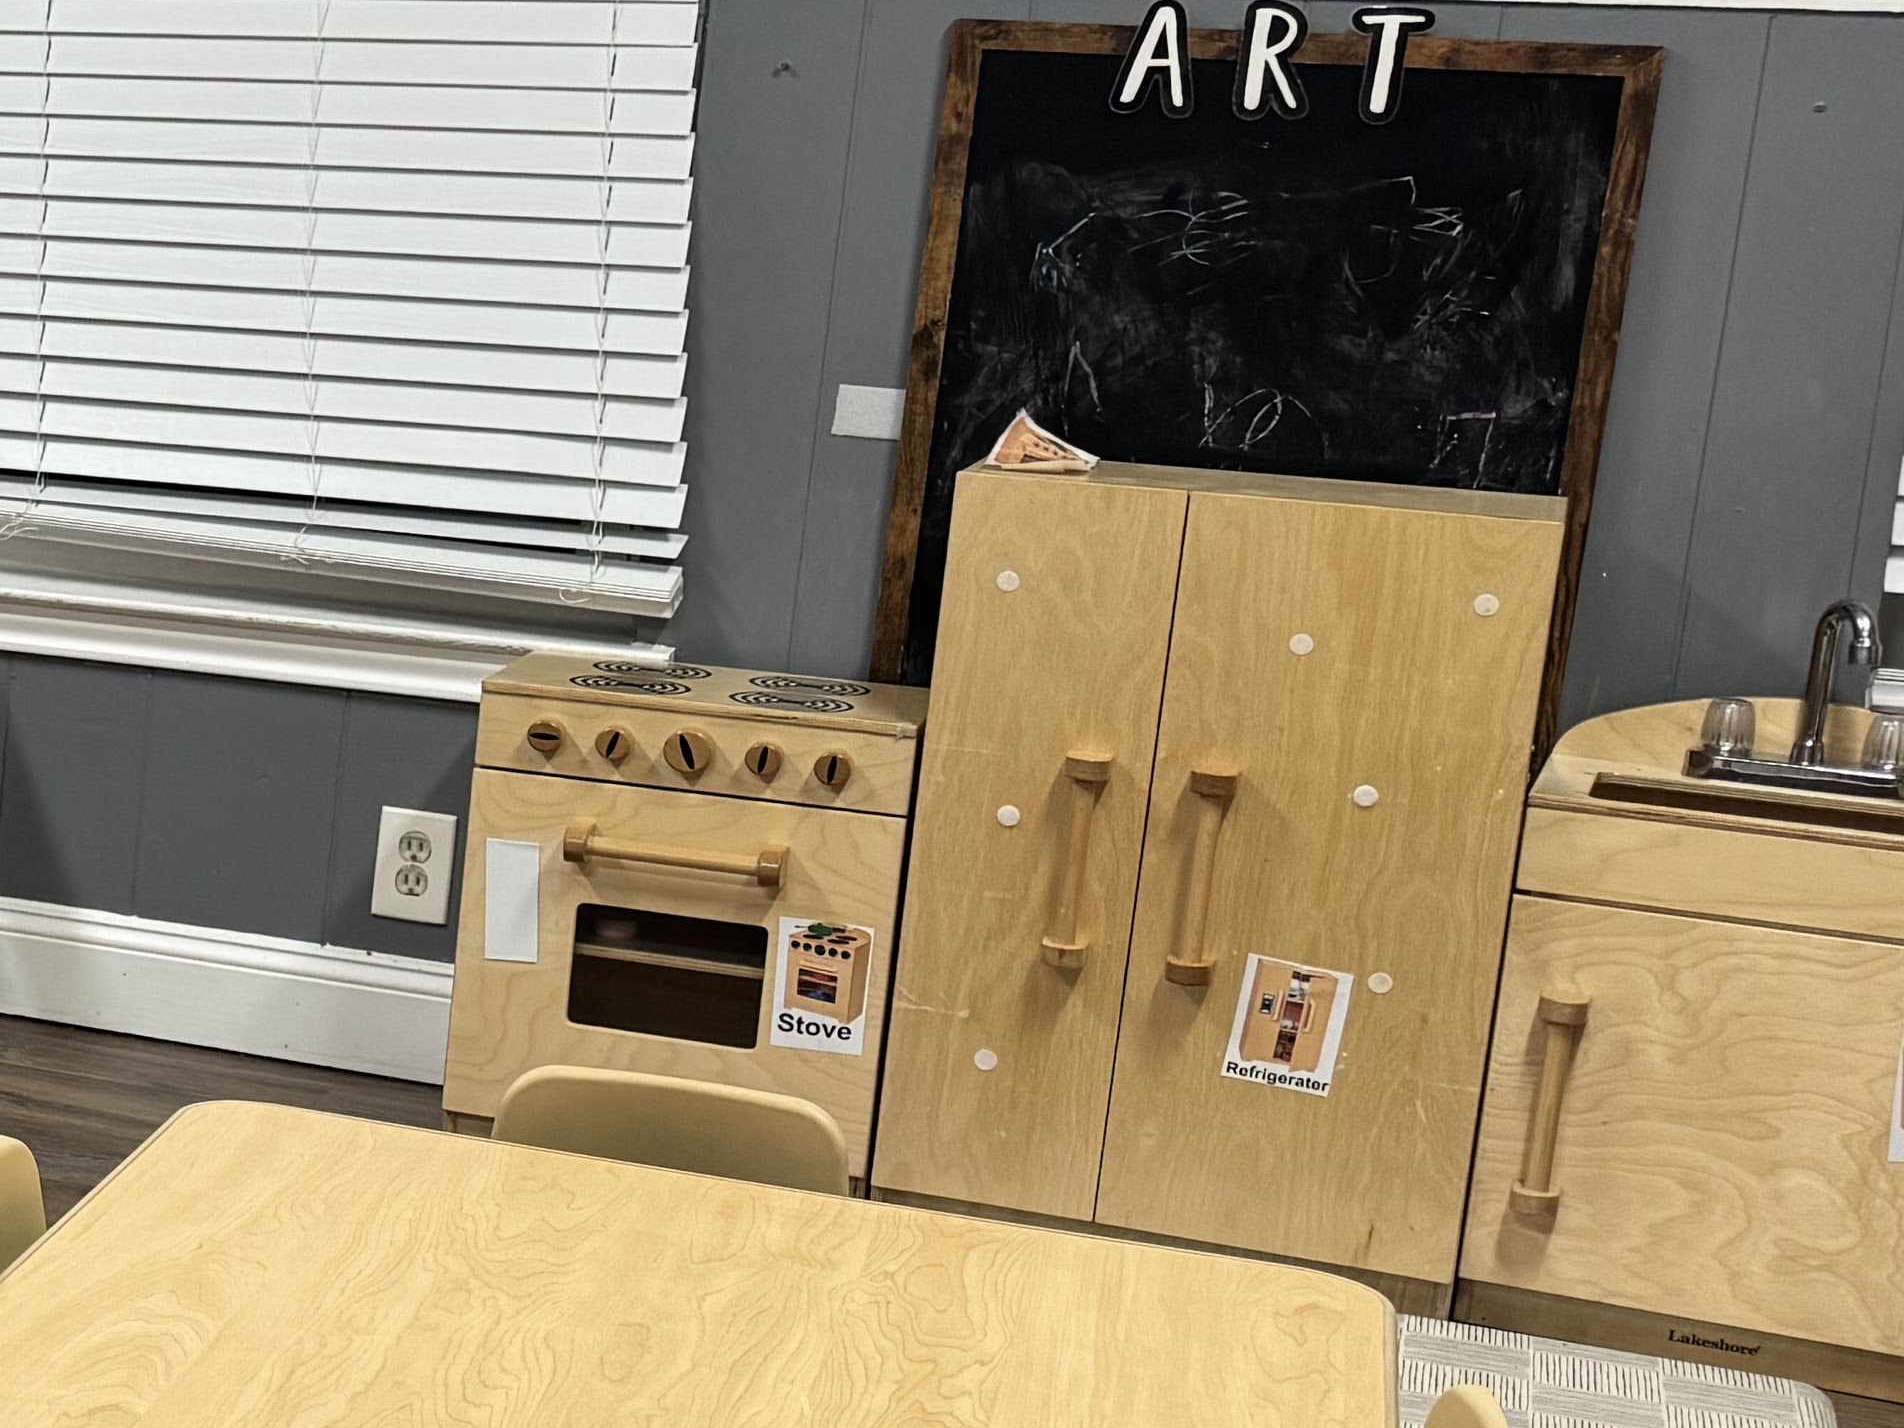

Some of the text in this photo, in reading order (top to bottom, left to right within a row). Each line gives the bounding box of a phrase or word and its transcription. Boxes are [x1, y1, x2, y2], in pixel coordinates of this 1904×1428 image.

[1109, 0, 1435, 123] ART
[777, 1012, 853, 1041] Stove
[1226, 1061, 1330, 1092] Refrigerator
[1668, 1329, 1761, 1357] Lakeshore
